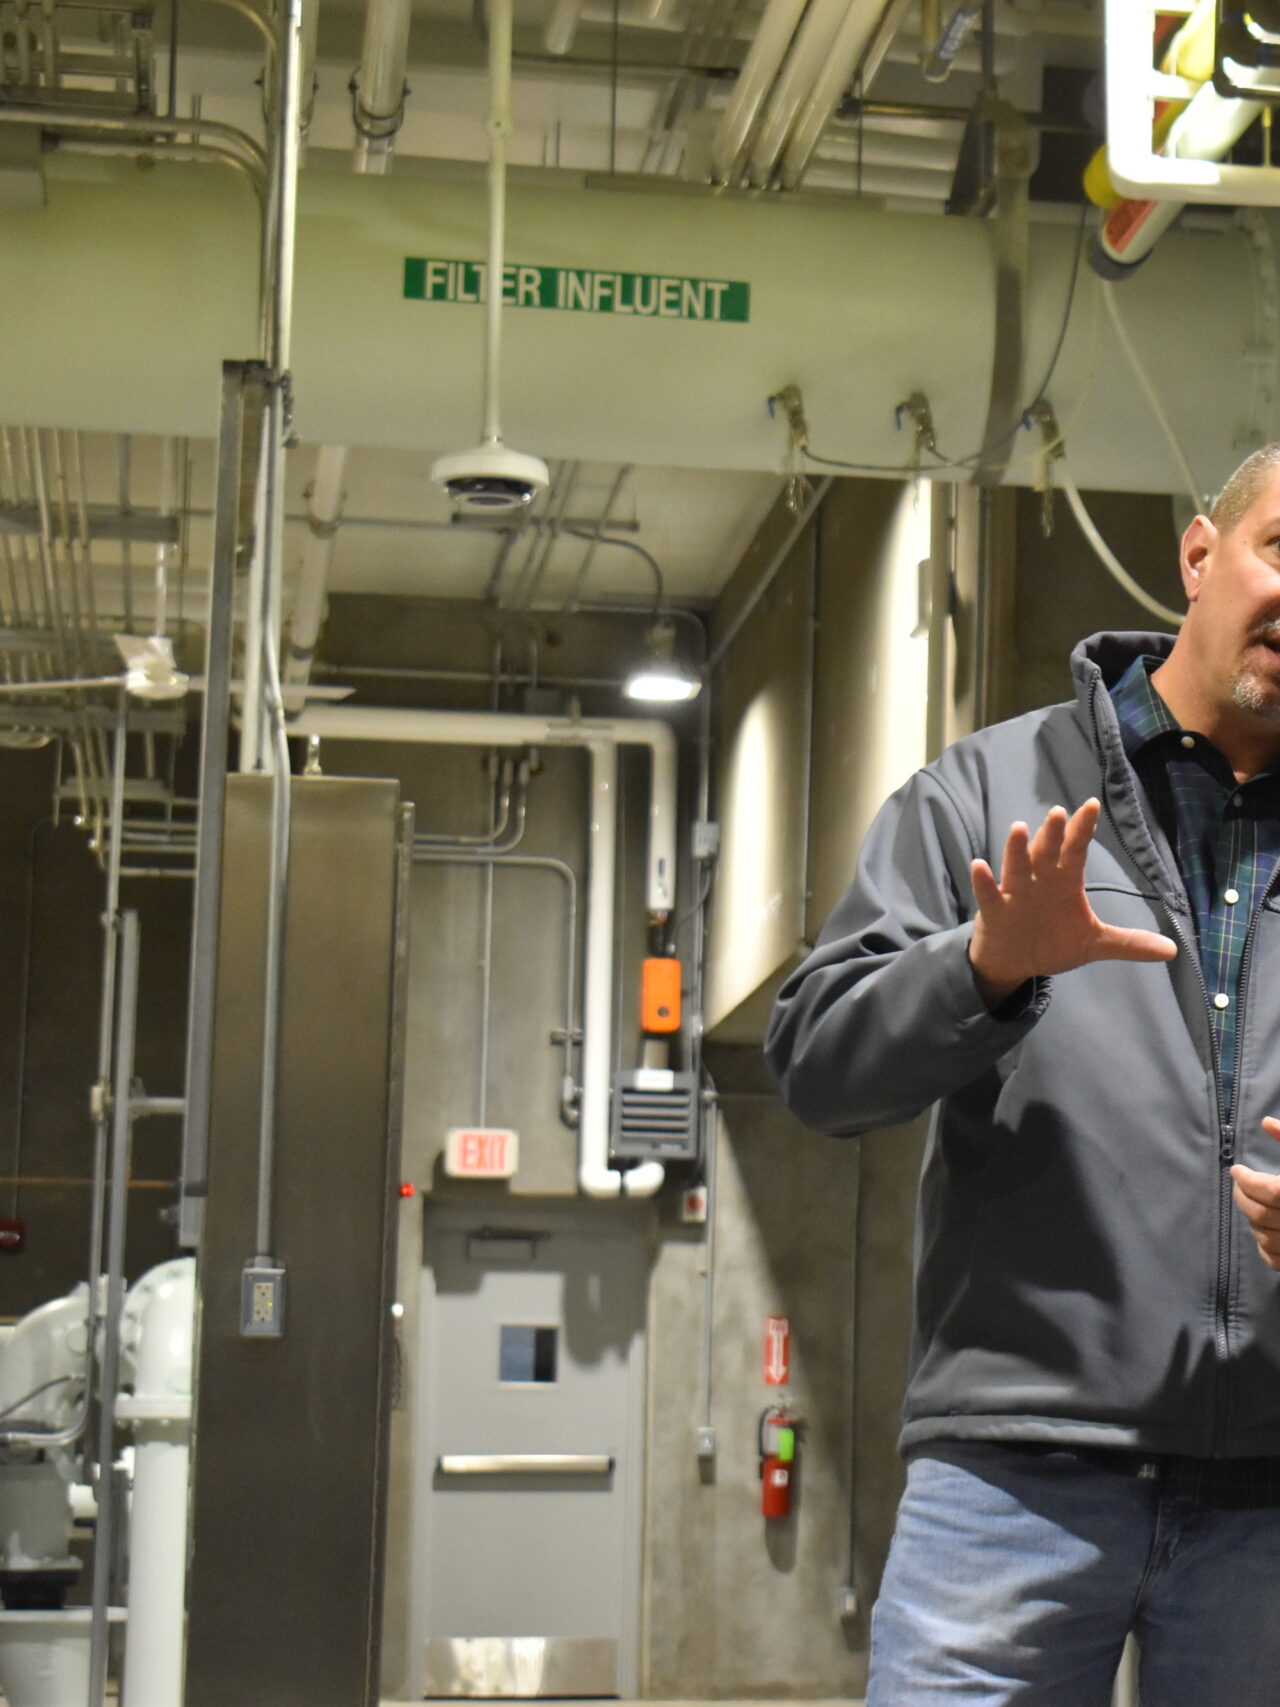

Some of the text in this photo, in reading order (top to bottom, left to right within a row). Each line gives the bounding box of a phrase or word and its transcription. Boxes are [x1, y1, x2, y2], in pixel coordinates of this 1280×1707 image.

[425, 260, 729, 320] FILTER INFLUENT
[461, 1132, 508, 1171] EXIT
